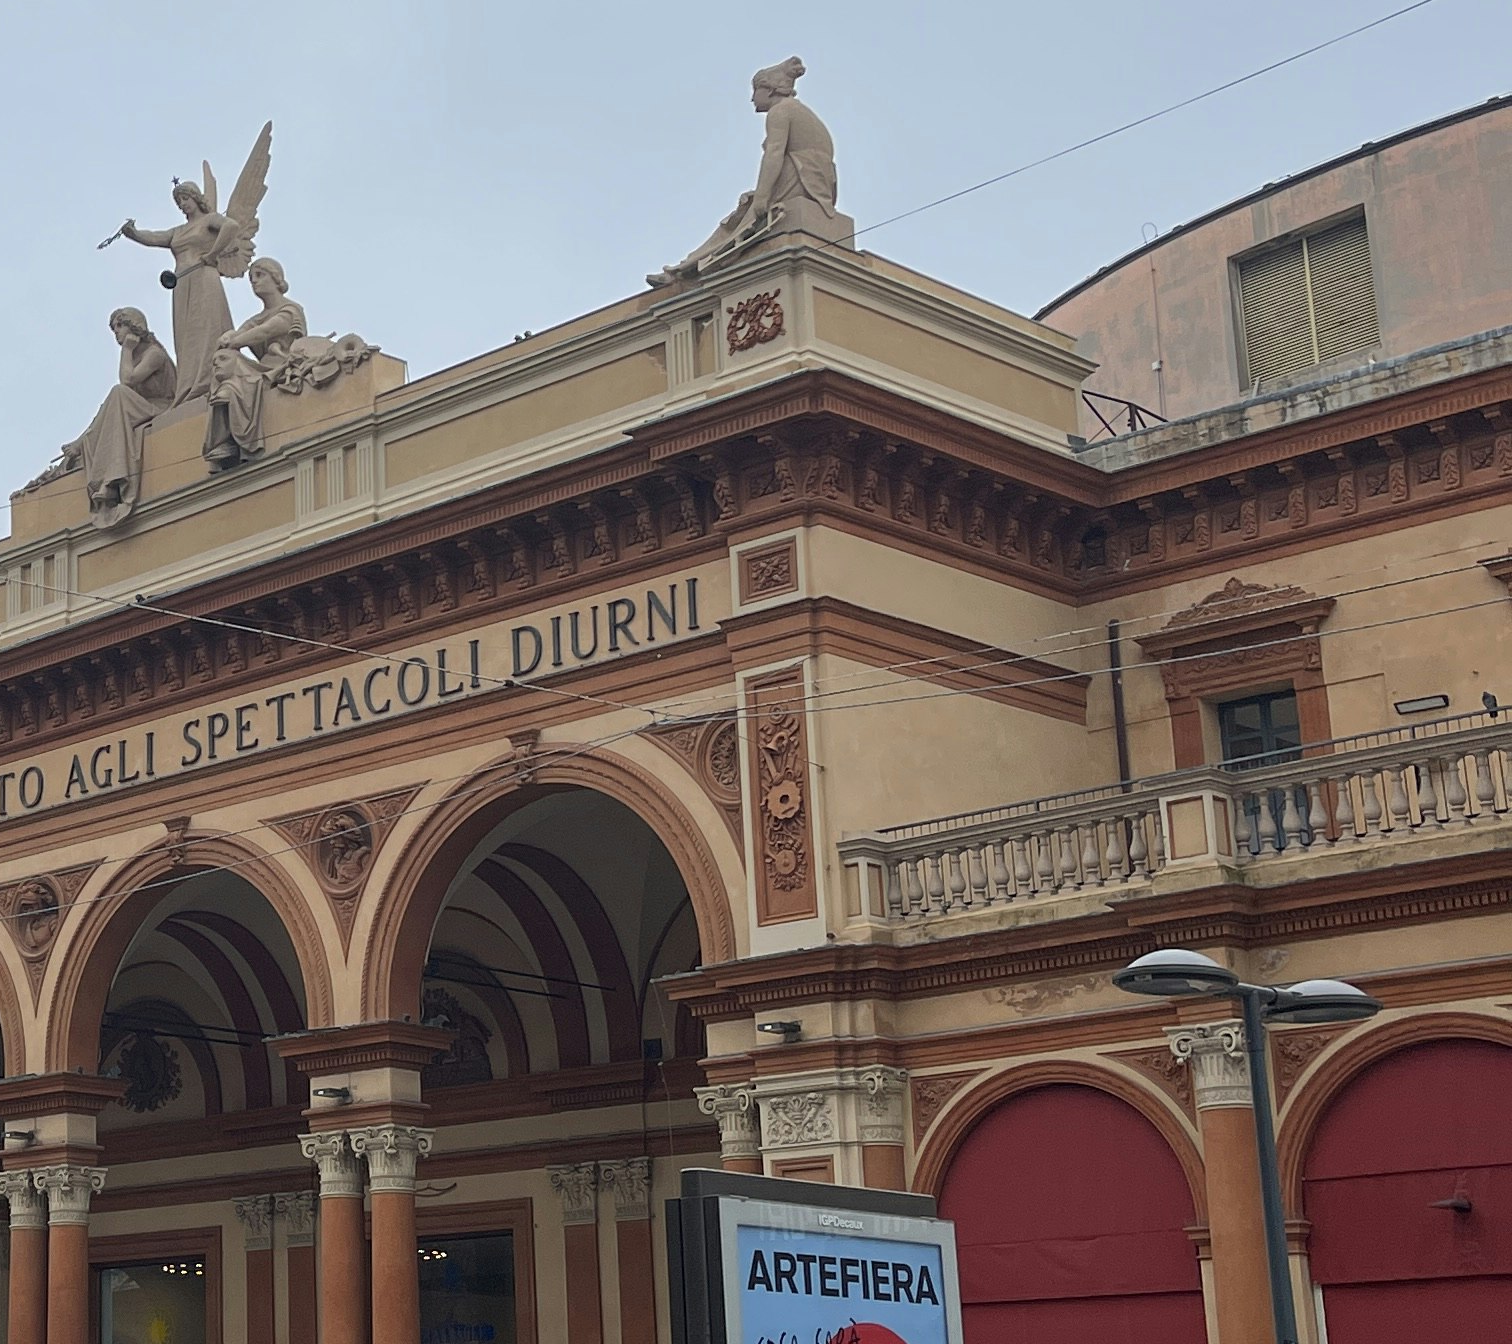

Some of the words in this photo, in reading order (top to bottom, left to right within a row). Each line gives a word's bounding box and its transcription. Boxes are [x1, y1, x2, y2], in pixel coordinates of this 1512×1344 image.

[64, 732, 155, 799] AGLI
[181, 639, 481, 767] SPETTACOLI
[511, 577, 700, 677] DIURNI
[747, 1249, 940, 1306] ARTEFIERA
